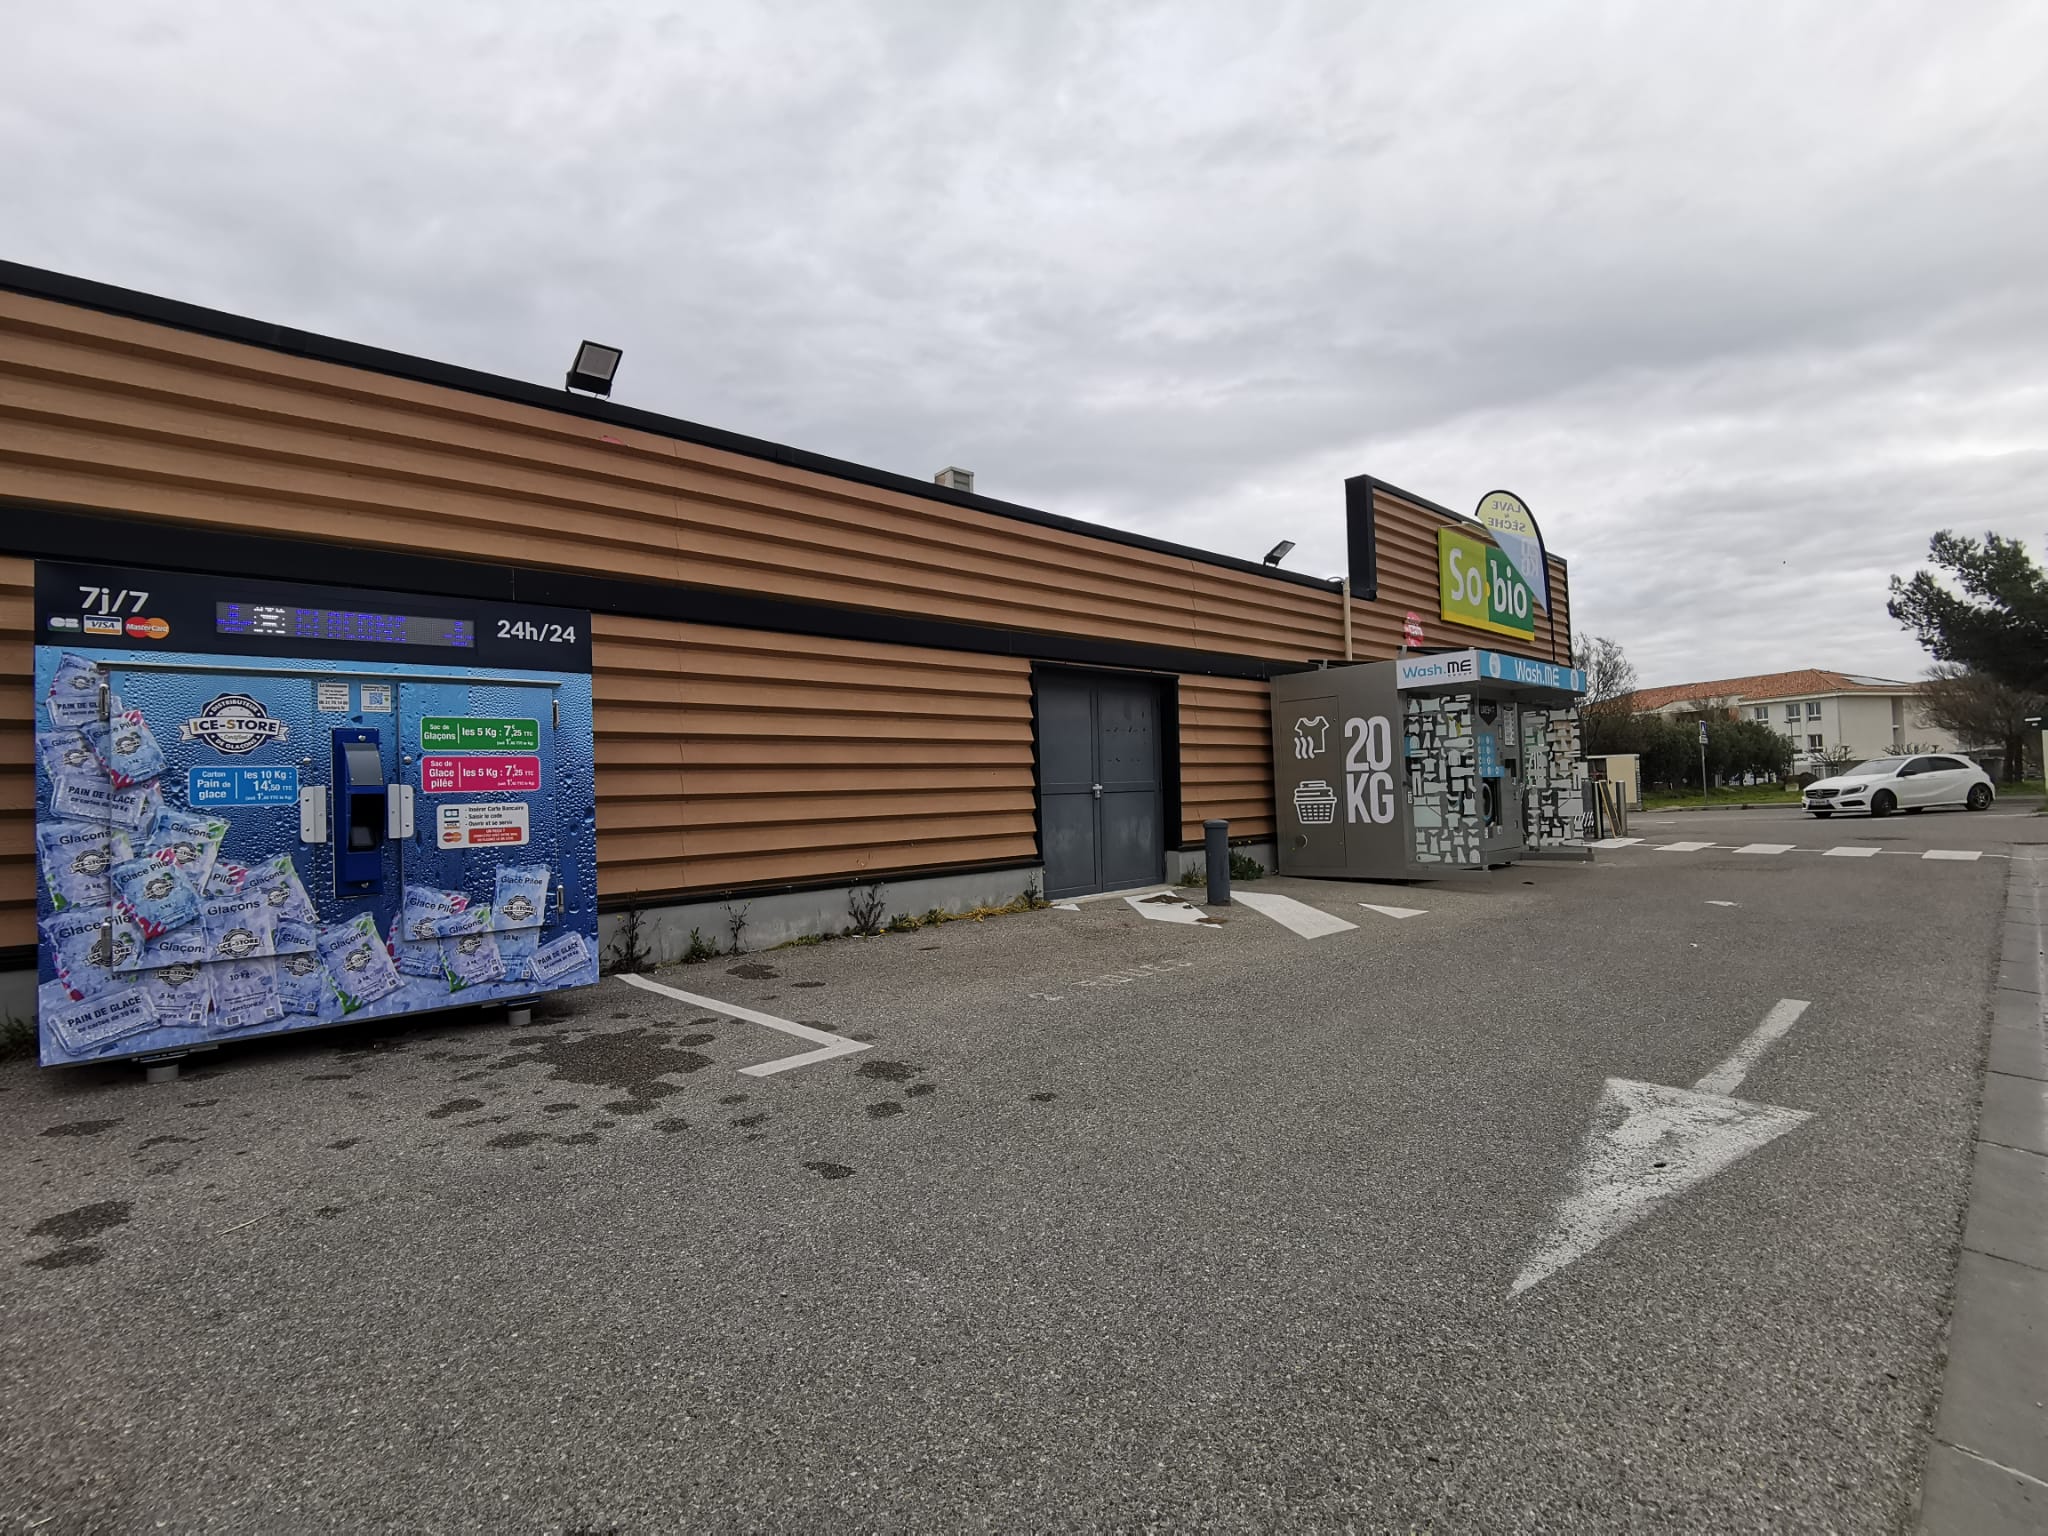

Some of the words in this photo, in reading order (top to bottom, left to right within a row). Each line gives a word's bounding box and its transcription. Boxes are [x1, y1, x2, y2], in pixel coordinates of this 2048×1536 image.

[79, 586, 149, 615] 7j/7
[91, 621, 116, 629] VISA
[497, 619, 577, 643] 24h/24
[211, 699, 258, 712] DISTRIBUTEUR
[192, 719, 278, 732] ICE-STORE
[424, 732, 456, 741] Glaçons
[462, 727, 476, 736] les
[477, 728, 484, 736] 5
[485, 728, 498, 738] Kg
[1344, 715, 1392, 772] 20
[244, 771, 258, 779] les
[261, 771, 272, 779] 10
[274, 771, 287, 780] Kg
[429, 768, 454, 777] Glace
[463, 768, 477, 776] les
[486, 768, 499, 778] Kg
[197, 779, 220, 788] Pain
[431, 779, 453, 789] pilée
[68, 786, 91, 797] PAIN
[92, 788, 105, 799] DE
[198, 790, 227, 800] glace
[1346, 771, 1395, 824] KG
[171, 822, 212, 839] Glaçons
[59, 830, 112, 845] Glaçons
[120, 867, 149, 884] Glace
[207, 899, 261, 916] Glaçons
[409, 897, 436, 910] Glace
[59, 918, 101, 939] Glace
[329, 931, 369, 951] Glaçons
[67, 1014, 94, 1028] PAIN
[94, 1008, 109, 1019] DE
[110, 996, 142, 1013] GLACE
